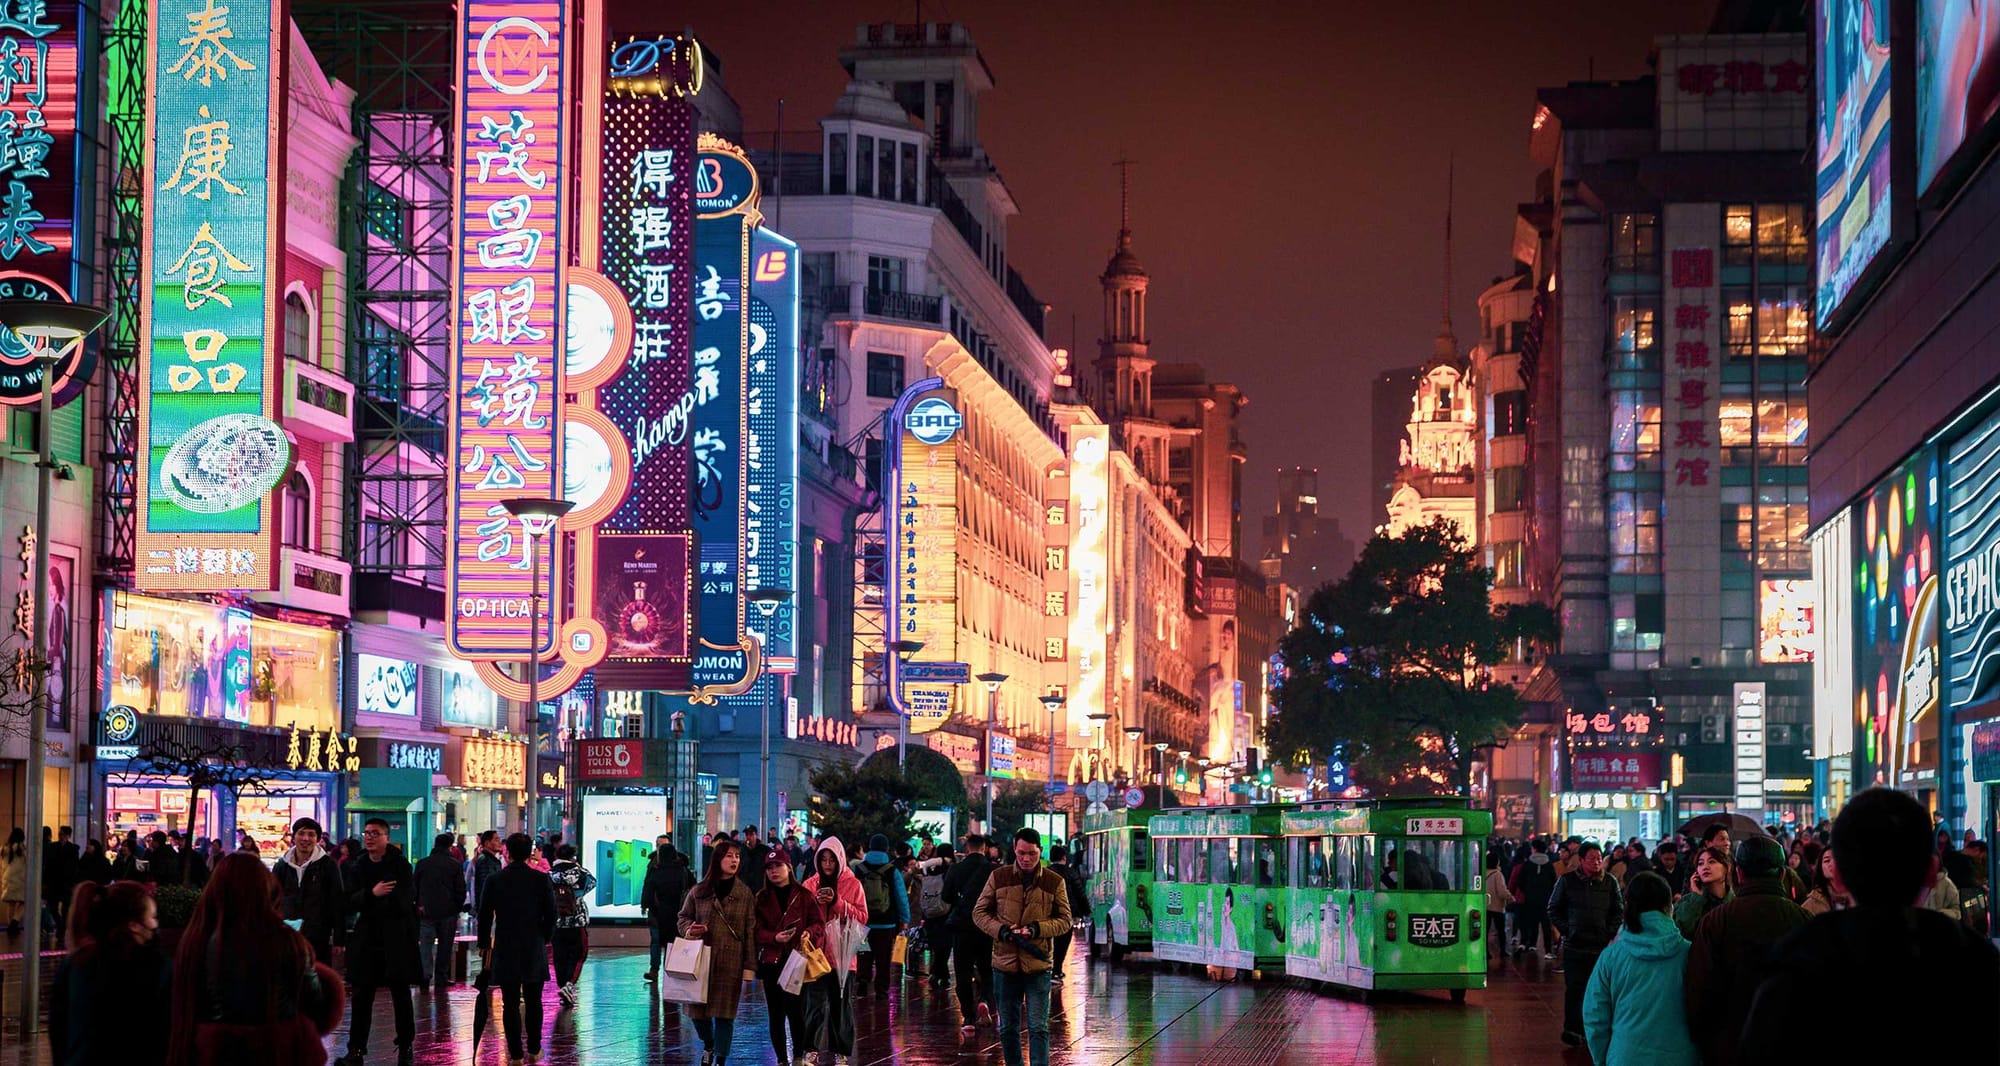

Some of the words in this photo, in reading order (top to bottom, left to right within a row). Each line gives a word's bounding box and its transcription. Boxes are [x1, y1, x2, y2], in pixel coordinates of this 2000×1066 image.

[161, 0, 256, 393] 泰康食品
[906, 414, 962, 428] BAC
[778, 483, 793, 529] No.1
[702, 673, 735, 681] WEAR
[286, 728, 361, 772] 泰康食品
[587, 745, 612, 758] BUS
[587, 758, 613, 767] TOUR
[1411, 917, 1456, 938] 豆本豆
